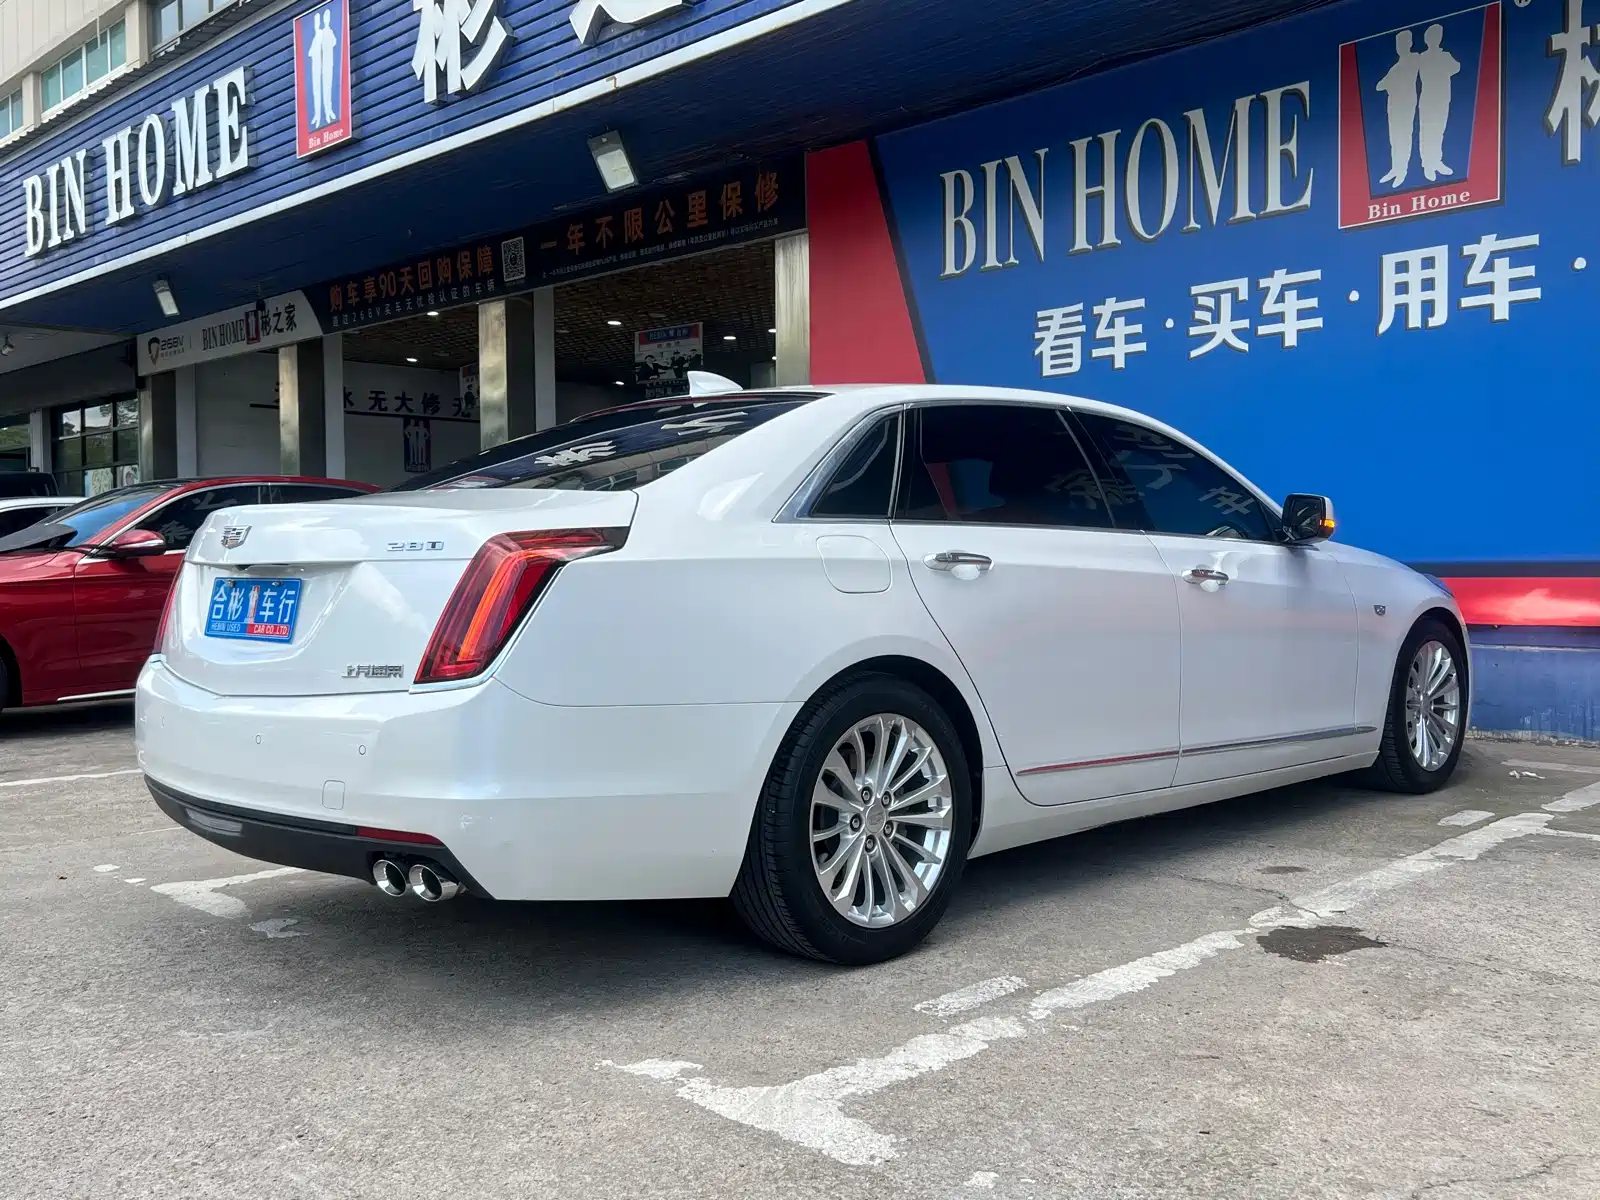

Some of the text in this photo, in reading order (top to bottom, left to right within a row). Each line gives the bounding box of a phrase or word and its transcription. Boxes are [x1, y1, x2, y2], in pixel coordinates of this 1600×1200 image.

[308, 129, 344, 149] Bin Home
[23, 66, 250, 258] BIN HOME
[939, 80, 1314, 279] BIN HOME
[539, 171, 780, 255] 一年不限公里保修
[1367, 190, 1471, 220] Bin Home
[329, 245, 494, 313] 购车享90天回购保障
[202, 325, 218, 351] BIN
[219, 318, 246, 346] HOME
[261, 302, 298, 337] 彬之家
[386, 541, 444, 552] 28T
[211, 586, 297, 623] 合彬 车行
[226, 623, 241, 633] USED
[253, 624, 265, 635] CAR
[341, 664, 405, 679] 上汽通用
